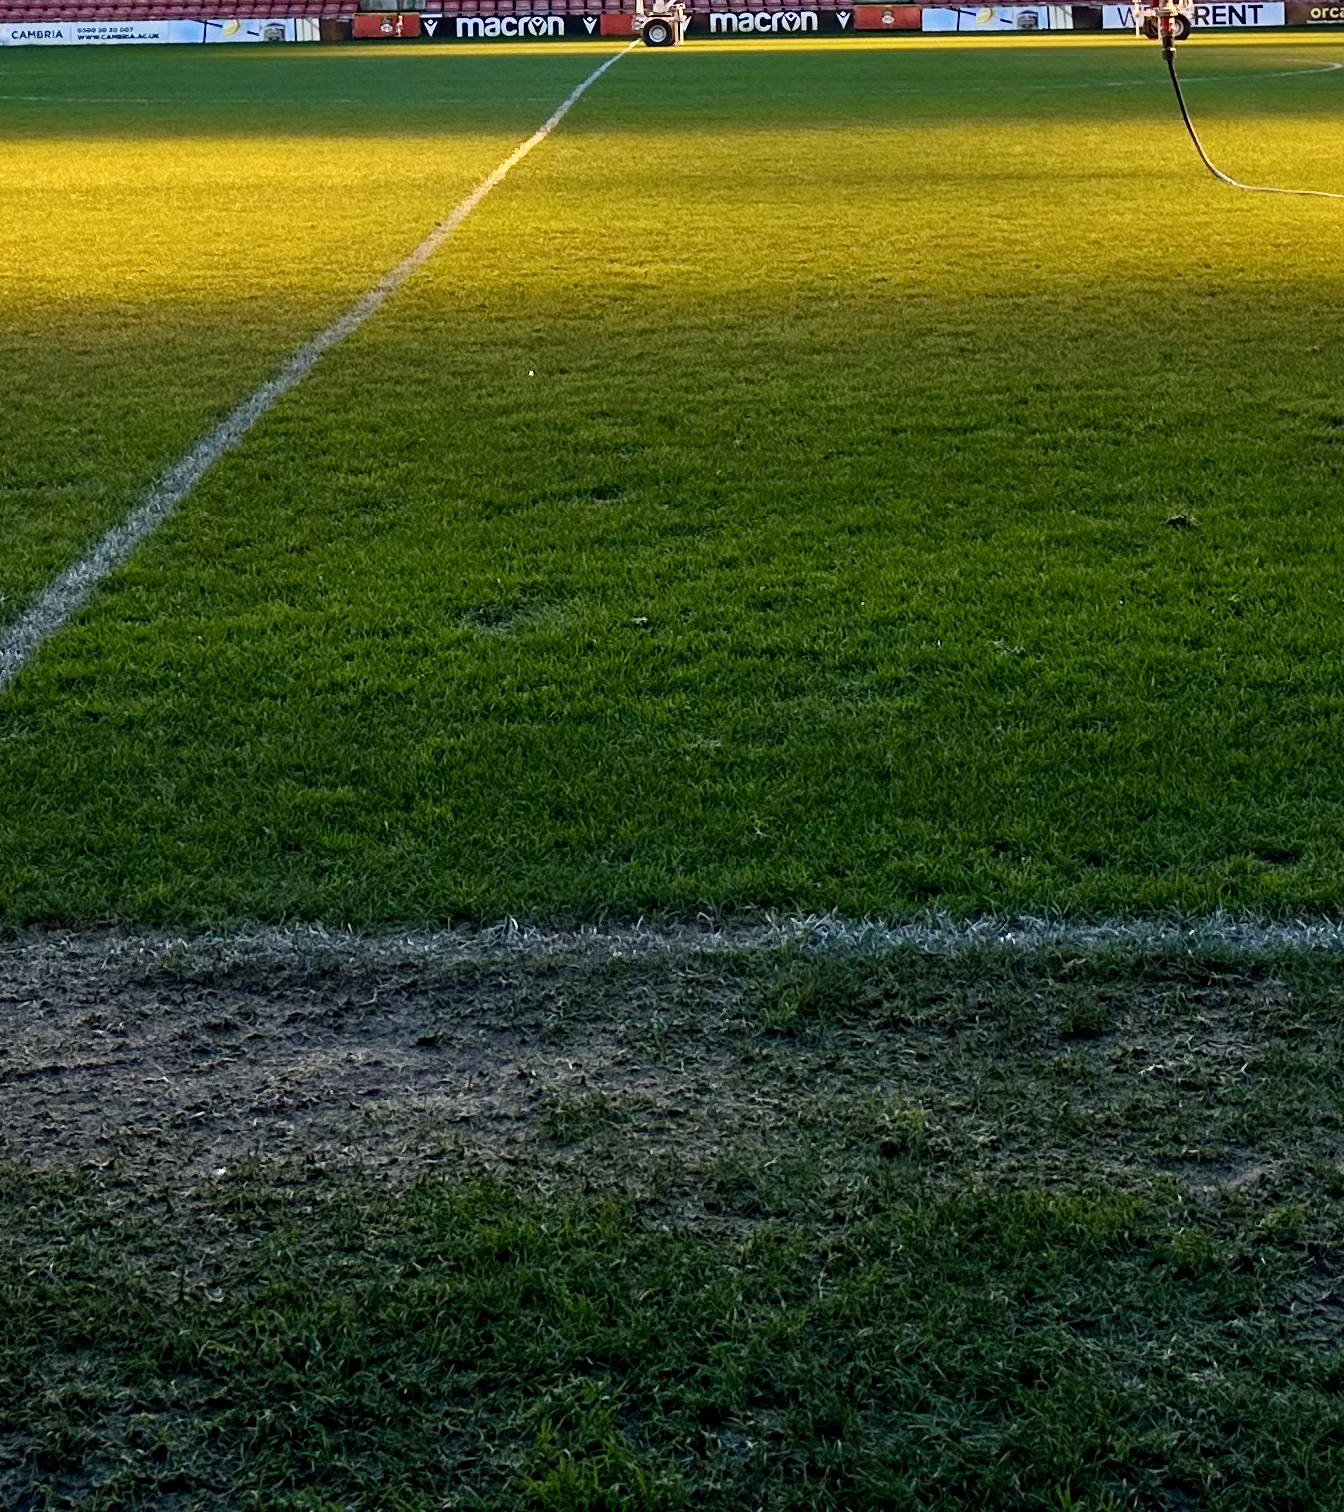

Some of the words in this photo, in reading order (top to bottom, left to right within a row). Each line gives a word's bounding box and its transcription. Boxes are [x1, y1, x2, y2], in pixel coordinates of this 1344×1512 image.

[709, 10, 819, 33] macron
[1194, 4, 1264, 26] RENT
[11, 30, 64, 39] CAMBRIA
[456, 16, 565, 37] macron
